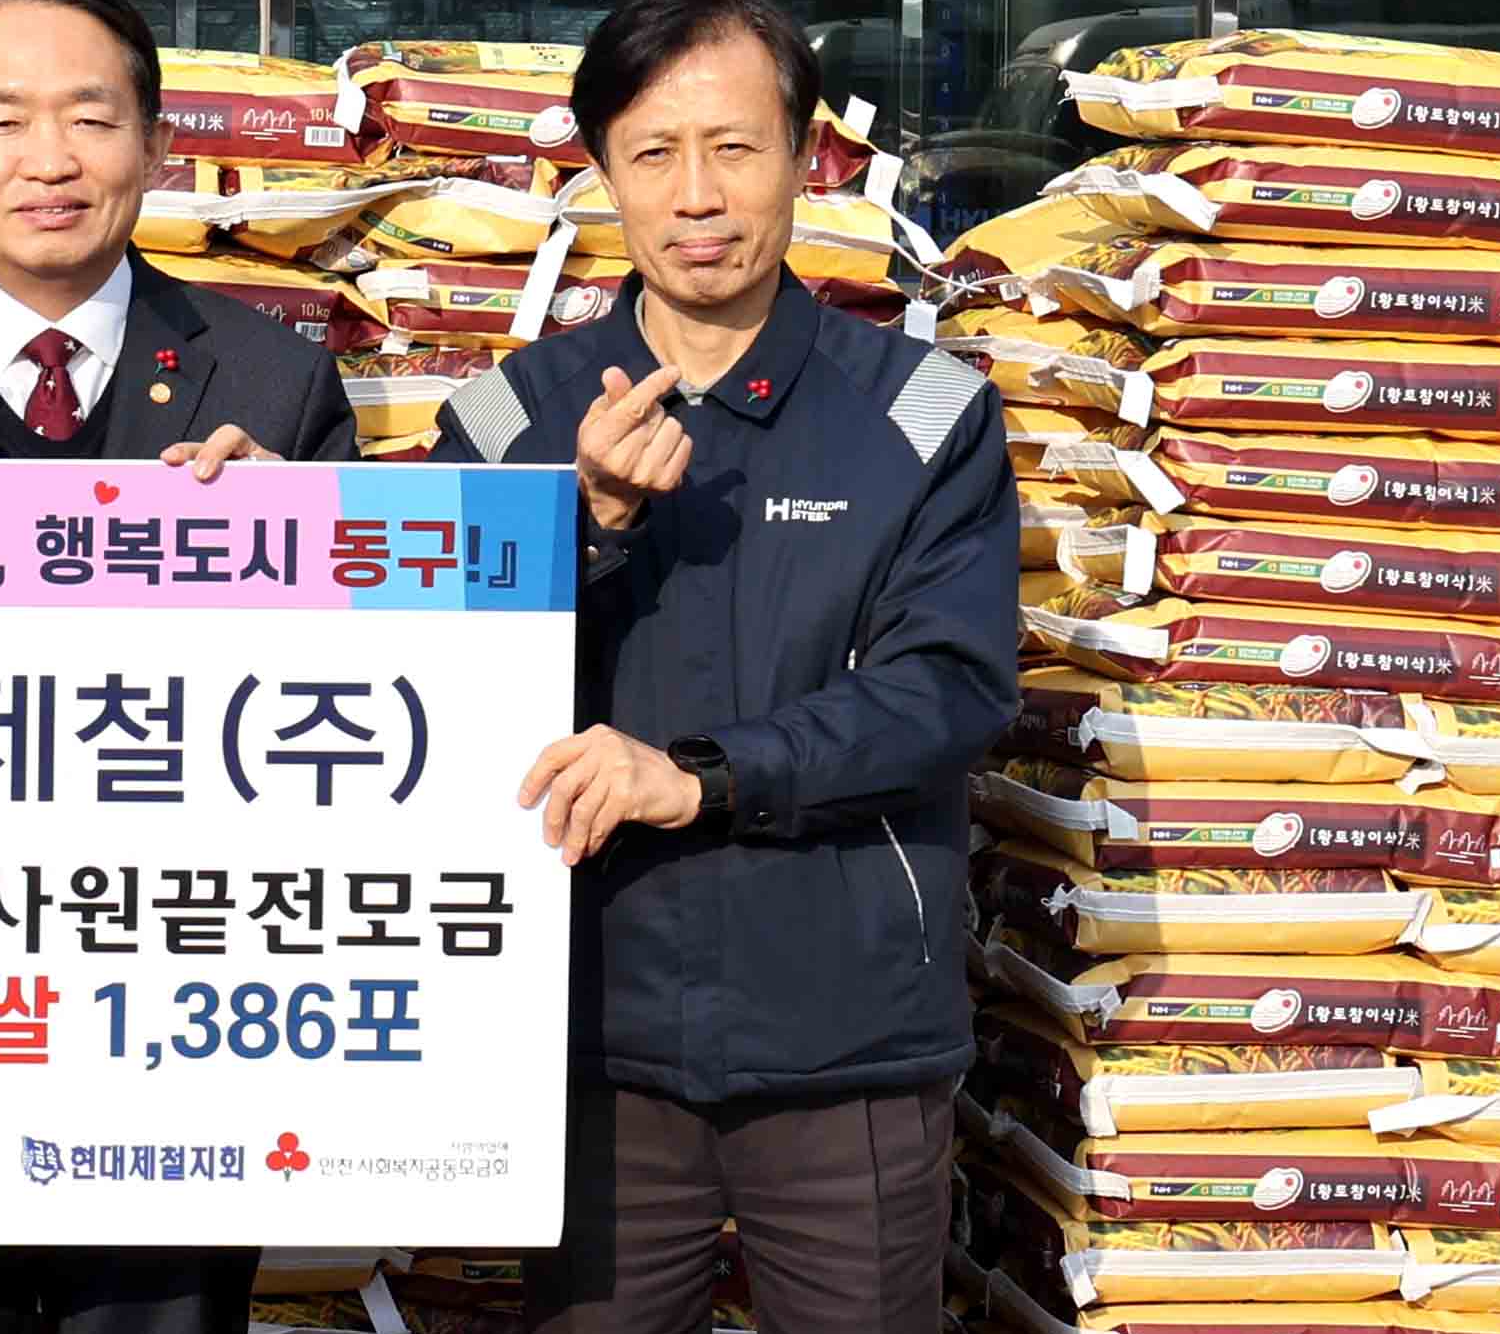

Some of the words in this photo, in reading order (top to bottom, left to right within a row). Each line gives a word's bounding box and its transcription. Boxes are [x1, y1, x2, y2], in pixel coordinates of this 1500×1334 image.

[310, 107, 336, 121] 10k
[791, 510, 831, 522] STEEL
[792, 499, 848, 511] HYUNDAI
[36, 515, 298, 586] 행복도시
[95, 979, 422, 1070] 1,386포
[71, 1145, 244, 1180] 현대제철지회
